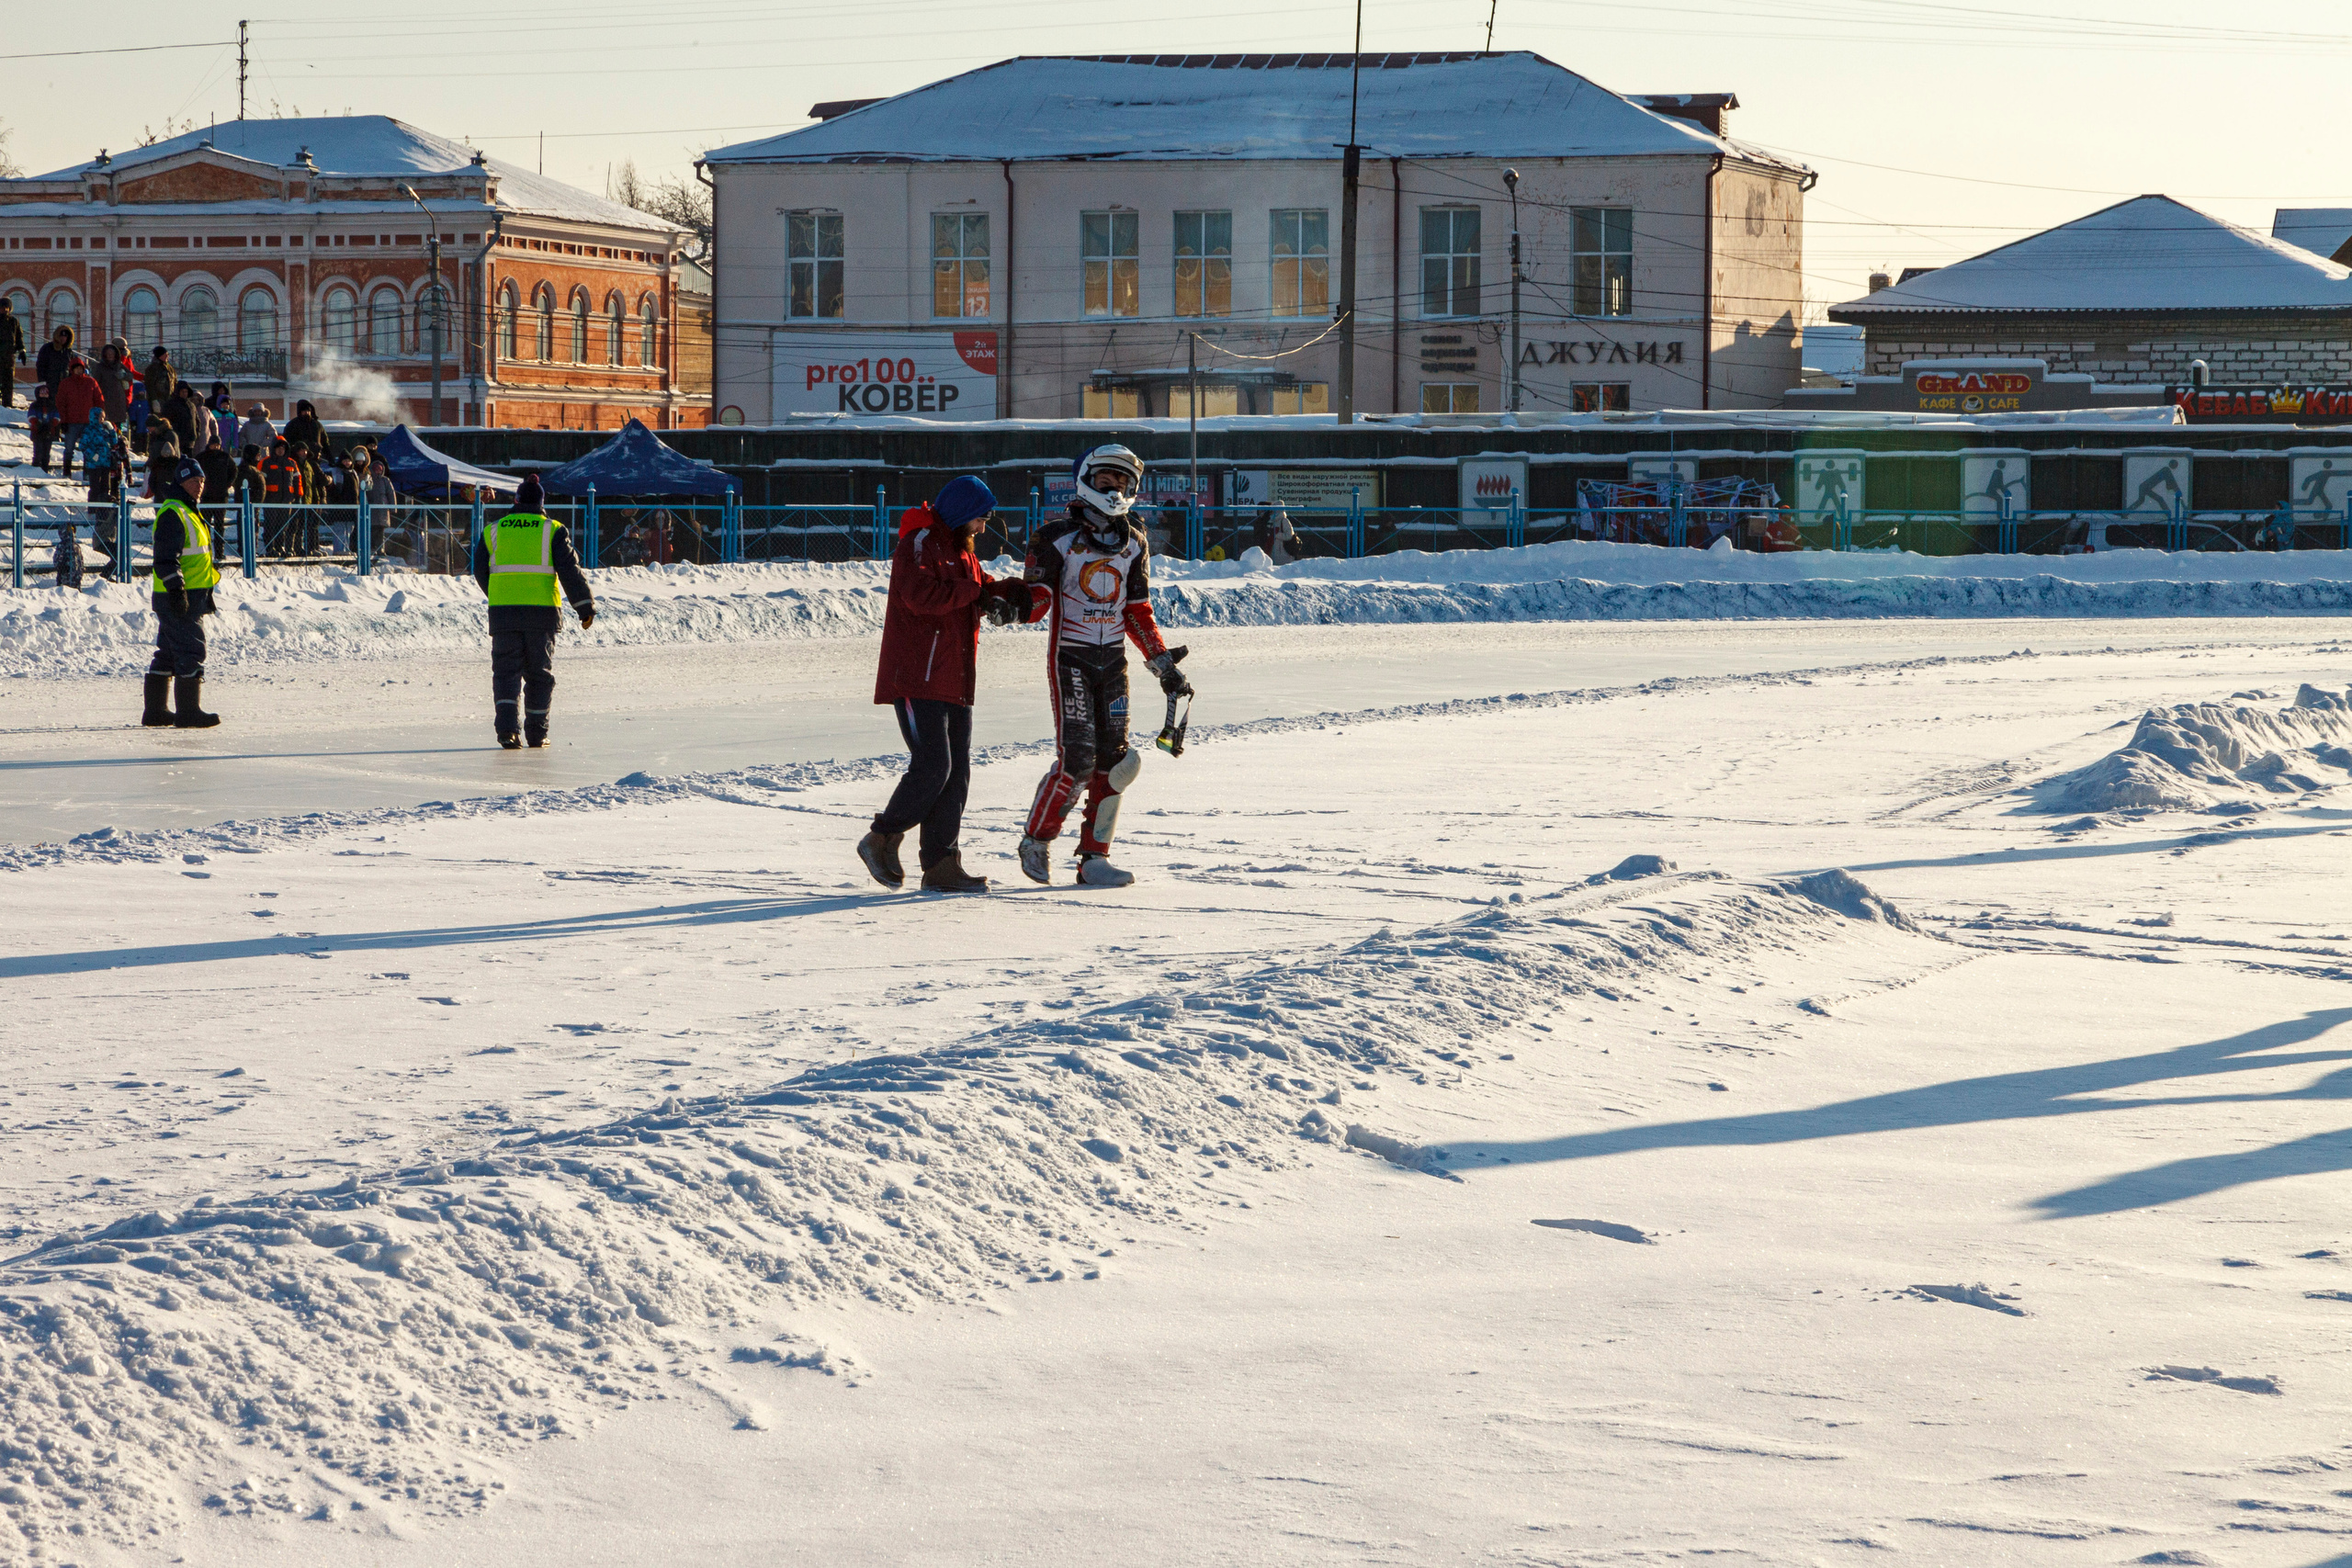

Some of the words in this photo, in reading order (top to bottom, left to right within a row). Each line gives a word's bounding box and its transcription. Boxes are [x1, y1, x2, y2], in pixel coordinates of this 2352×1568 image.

[966, 350, 995, 358] ЭТАЖ
[1520, 341, 1683, 368] ДЖУЛИЯ
[1917, 372, 2031, 394] GRAND
[1919, 398, 1956, 409] КАФЕ
[1989, 398, 2020, 409] CAFE
[1313, 472, 1348, 480] наружной
[1049, 481, 1076, 491] ВПЕ
[1061, 493, 1077, 502] СВ
[1227, 497, 1255, 505] ЗБРА
[501, 519, 540, 528] СУДЬЯ
[1083, 608, 1117, 616] УГМК
[1070, 667, 1088, 721] RACING
[1065, 697, 1076, 719] ICE
[1165, 691, 1177, 728] 100%
